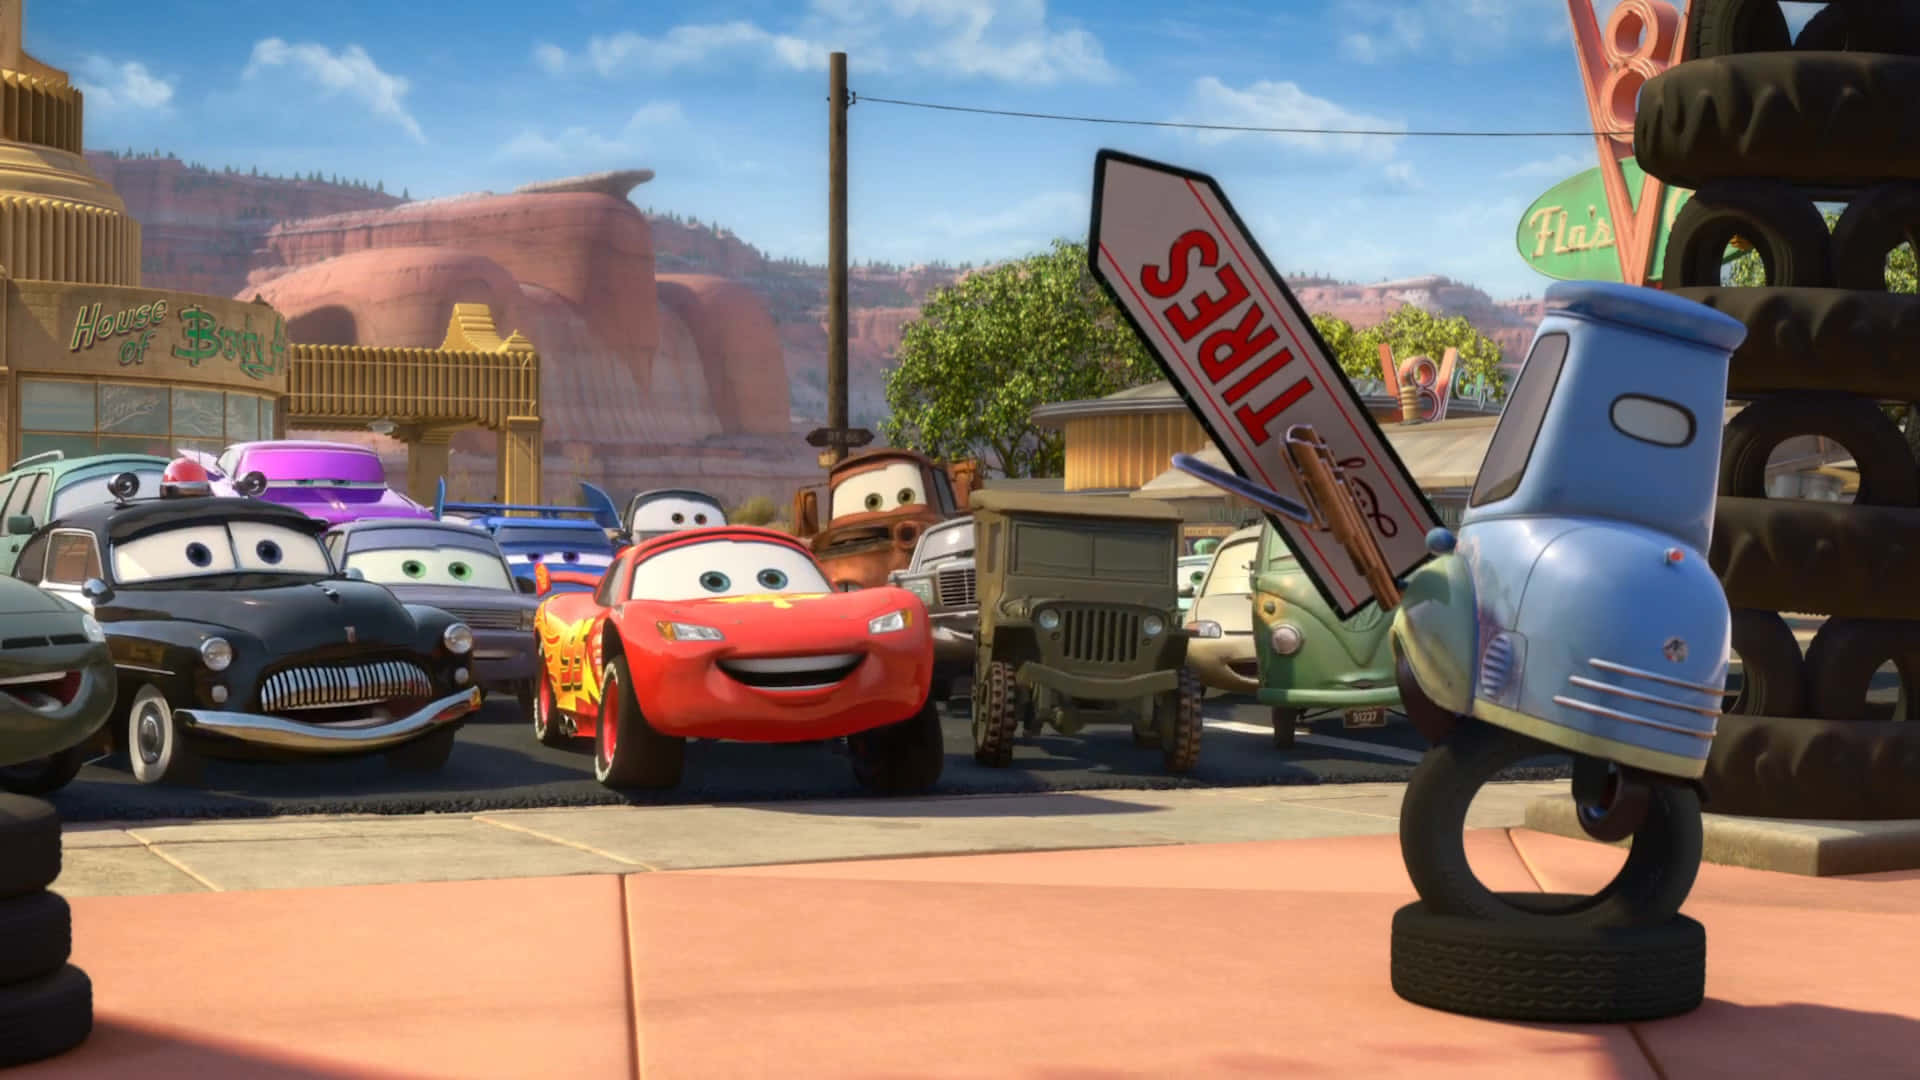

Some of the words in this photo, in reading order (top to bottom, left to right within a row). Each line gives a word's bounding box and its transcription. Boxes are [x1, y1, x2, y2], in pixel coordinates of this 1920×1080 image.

[70, 299, 168, 351] House
[119, 328, 157, 367] of
[1140, 228, 1314, 447] TIRES
